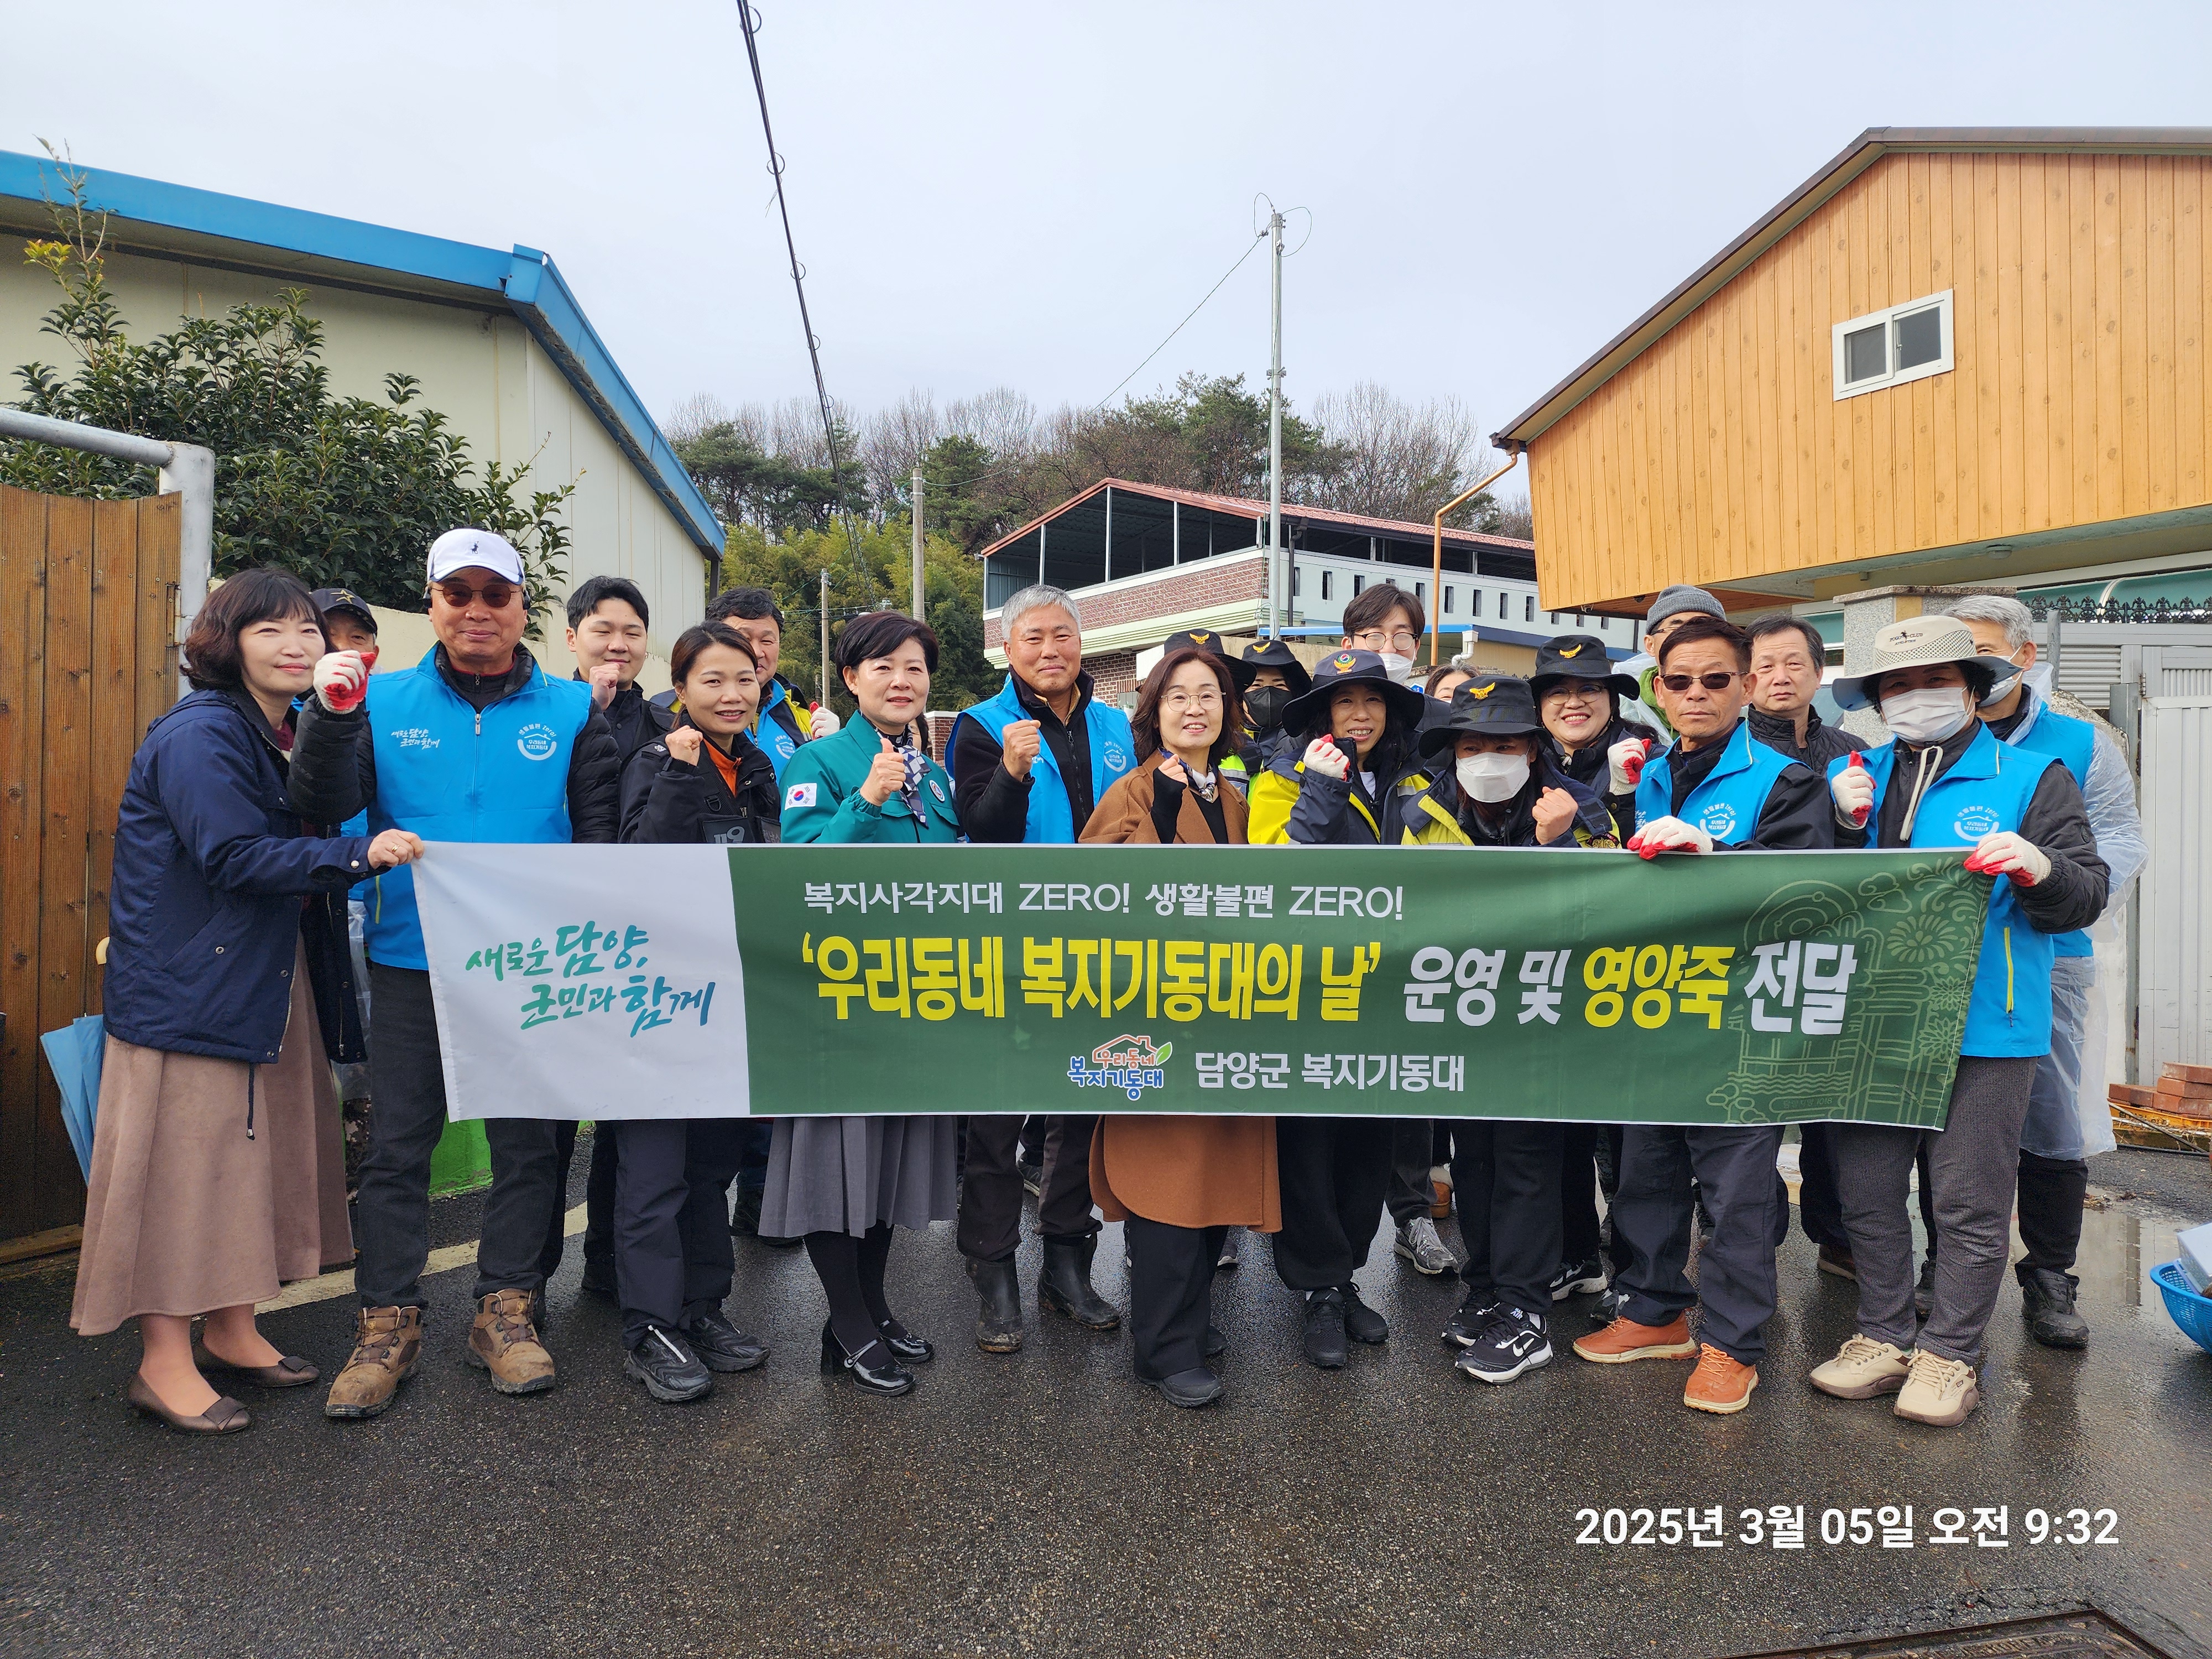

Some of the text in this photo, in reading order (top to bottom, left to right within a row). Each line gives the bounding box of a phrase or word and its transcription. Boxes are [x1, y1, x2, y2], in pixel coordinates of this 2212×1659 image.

[714, 826, 745, 843] 119
[804, 882, 1403, 920] 복지사각지대 ZERO! 생활불편 ZERO!
[465, 921, 649, 982] 새로운 담양,
[1021, 937, 1303, 1022] 복지기동대의
[1403, 946, 1506, 1026] 운영
[1517, 949, 1572, 1025] 및
[1583, 944, 1735, 1029] 영양죽
[1744, 940, 1858, 1035] 전달
[520, 975, 716, 1038] 군민과 함께
[1067, 1056, 1164, 1101] 복지기동대
[1098, 1047, 1156, 1070] 우리동네
[1195, 1052, 1464, 1092] 담양군 복지기동대
[1510, 1311, 1523, 1320] AIR
